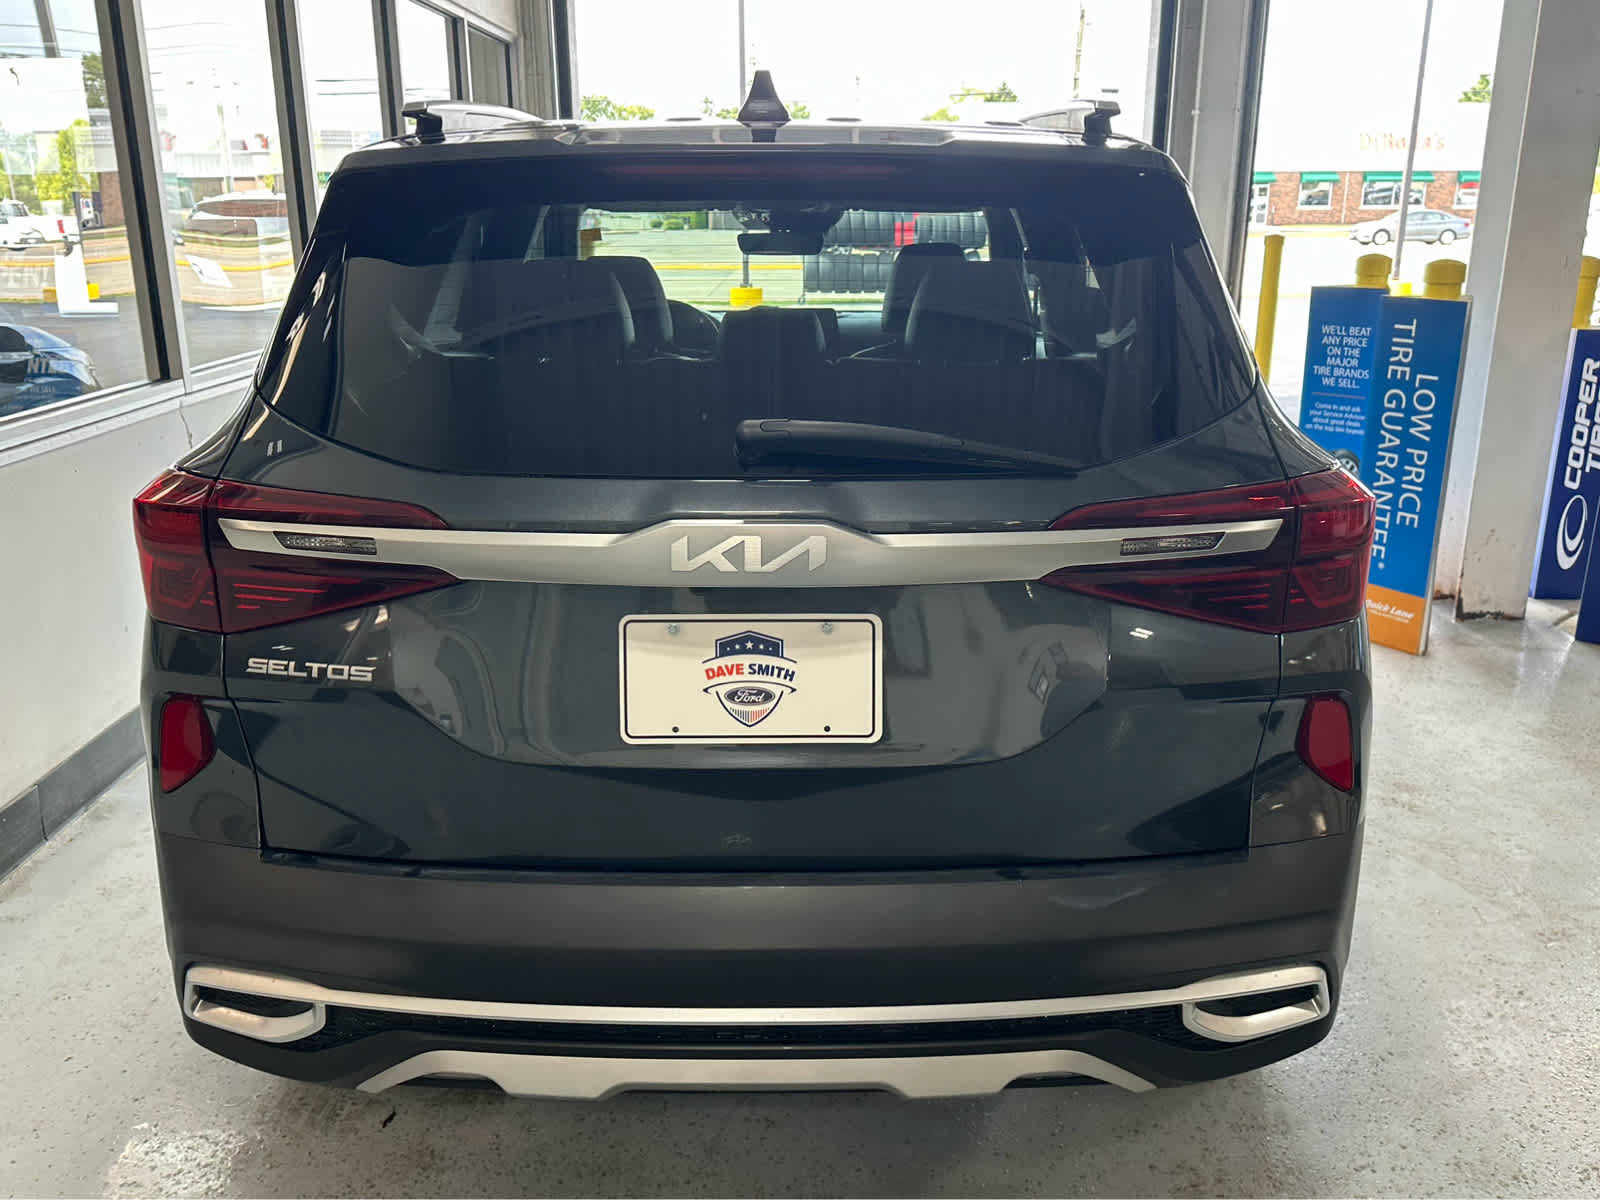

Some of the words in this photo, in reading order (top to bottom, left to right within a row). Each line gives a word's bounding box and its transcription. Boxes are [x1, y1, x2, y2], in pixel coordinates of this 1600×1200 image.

[1322, 324, 1346, 336] WE'LL
[1349, 327, 1372, 337] BEAT
[1322, 336, 1341, 345] ANY
[1343, 338, 1368, 347] PRICE
[1386, 318, 1417, 381] TIRE
[1327, 346, 1341, 356] ON
[1343, 347, 1360, 357] THE
[1327, 357, 1358, 367] MAJOR
[1313, 366, 1331, 376] TIRE
[1333, 368, 1369, 379] BRANDS
[1322, 377, 1335, 386] WE
[1338, 379, 1360, 388] SELL.
[1408, 373, 1439, 442] LOW
[1563, 357, 1600, 491] COOPER
[1395, 447, 1428, 529] PRICE
[670, 535, 828, 573] KIA
[245, 657, 377, 682] SELTOS
[704, 663, 744, 681] DAVE
[747, 663, 796, 682] SMITH
[733, 689, 766, 703] Ford
